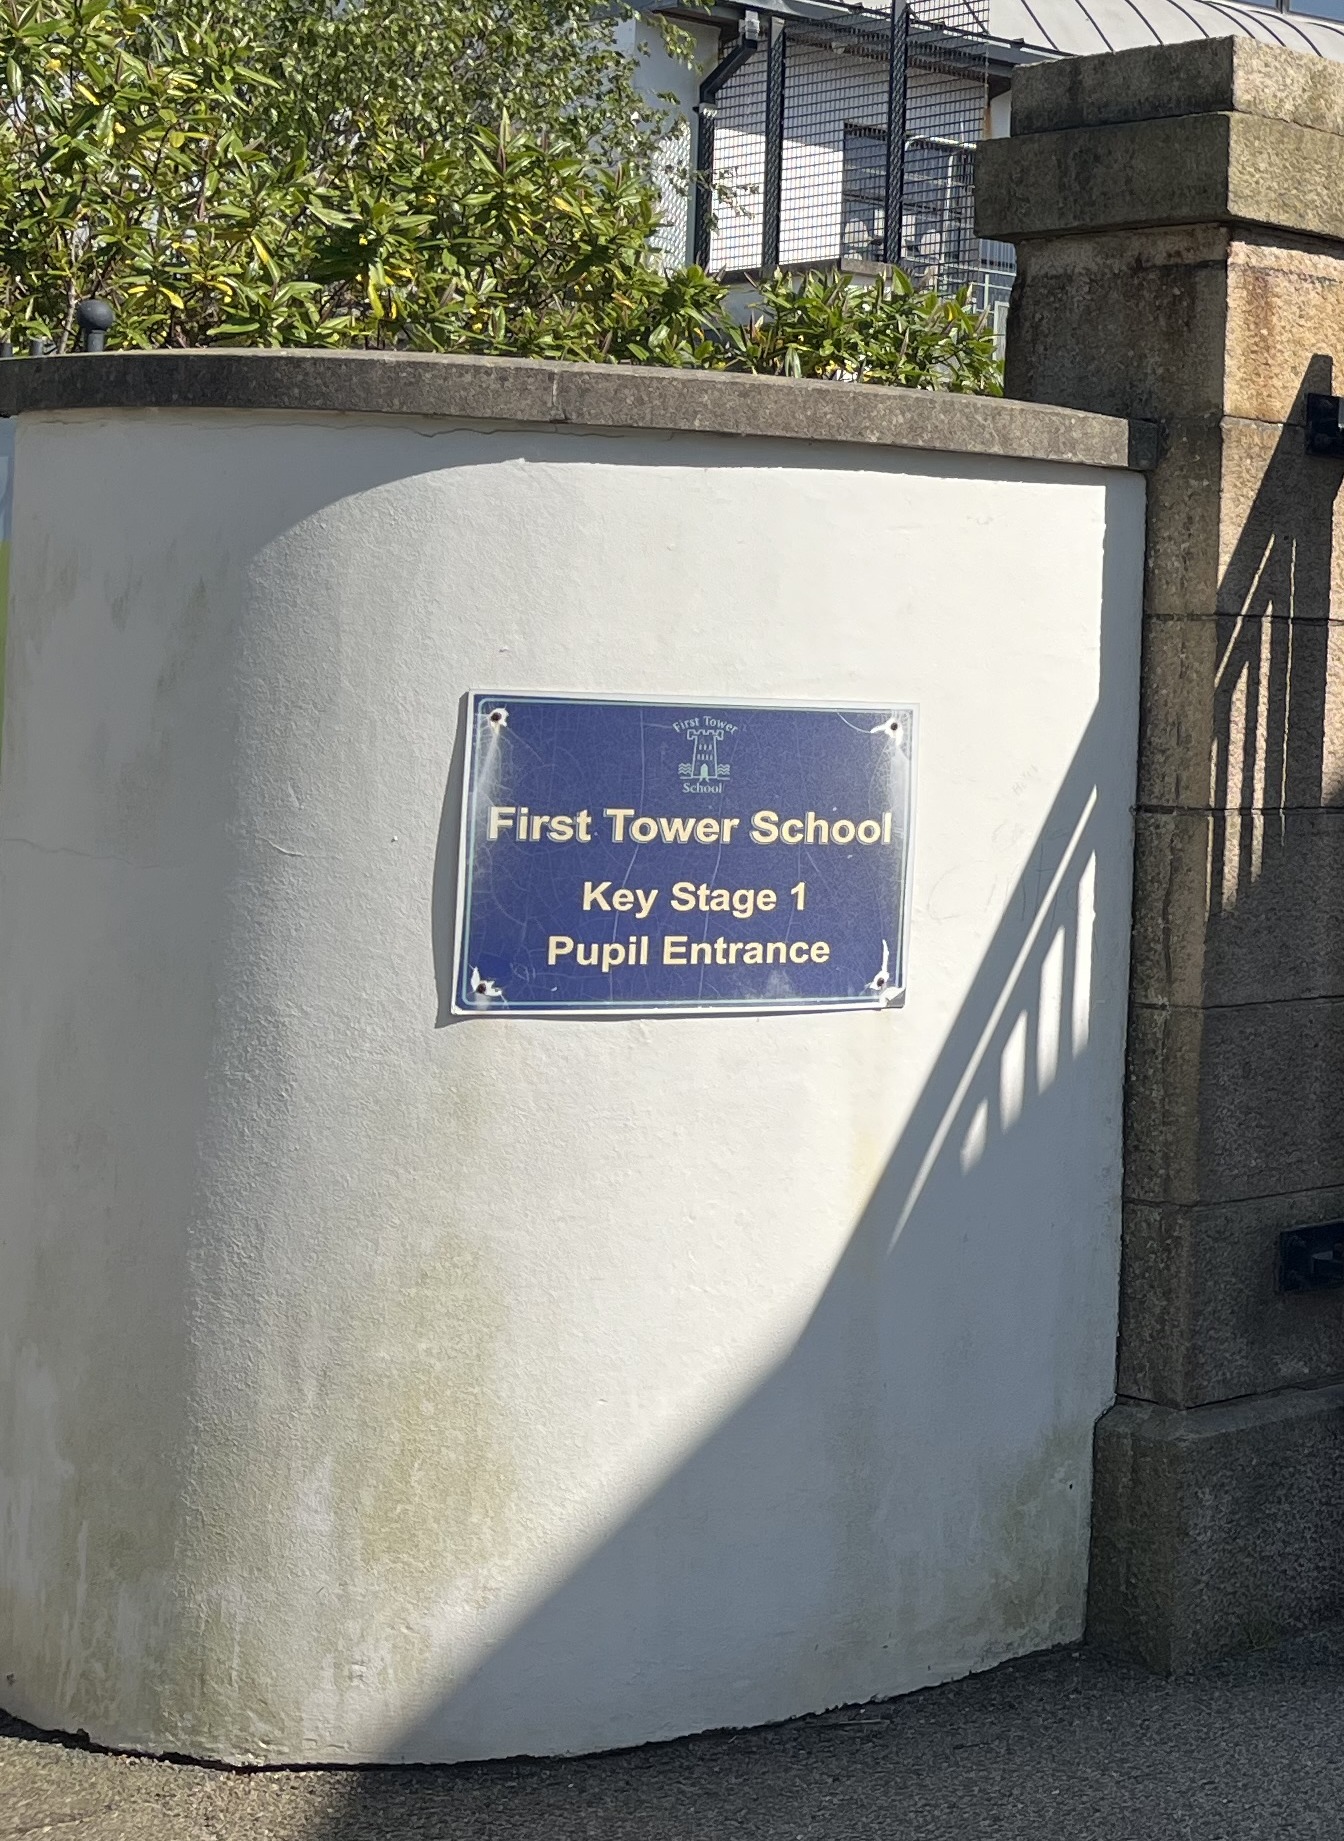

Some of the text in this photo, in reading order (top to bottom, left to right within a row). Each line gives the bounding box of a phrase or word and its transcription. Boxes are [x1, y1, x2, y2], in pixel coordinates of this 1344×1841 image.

[672, 715, 738, 735] First Tower
[682, 782, 722, 794] School
[488, 806, 893, 845] First Tower School
[582, 881, 807, 919] Key Stage 1
[547, 935, 831, 972] Pupil Entrance
